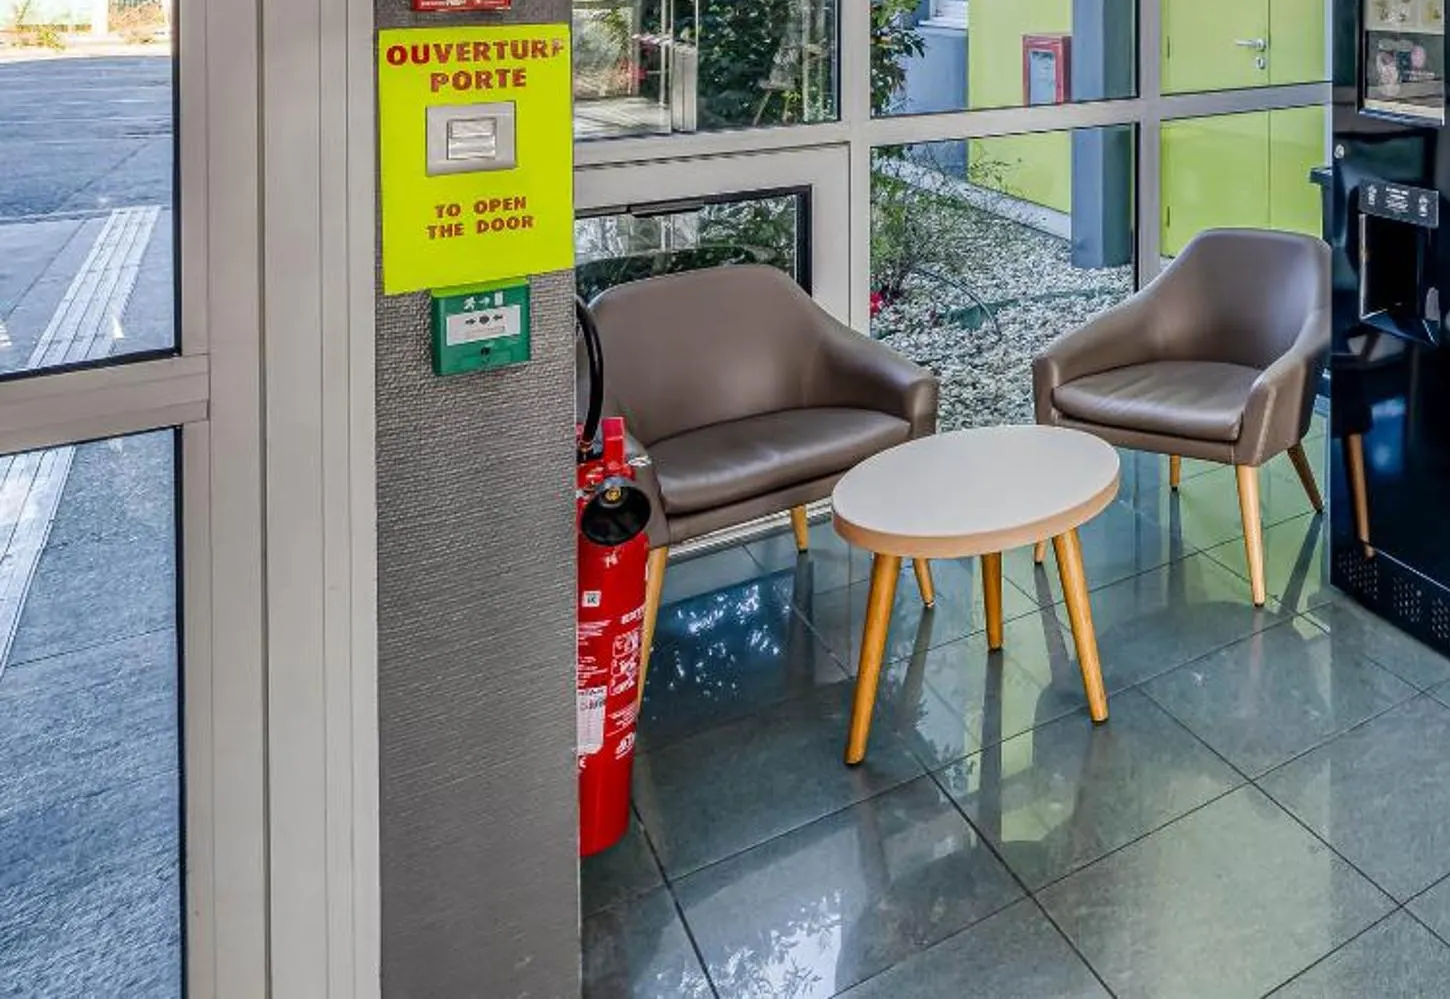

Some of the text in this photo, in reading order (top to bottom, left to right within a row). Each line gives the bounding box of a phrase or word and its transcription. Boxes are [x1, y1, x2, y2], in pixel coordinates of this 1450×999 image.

[430, 67, 527, 93] PORTE
[434, 196, 527, 219] TO OPEN
[426, 215, 534, 240] THE DOOR
